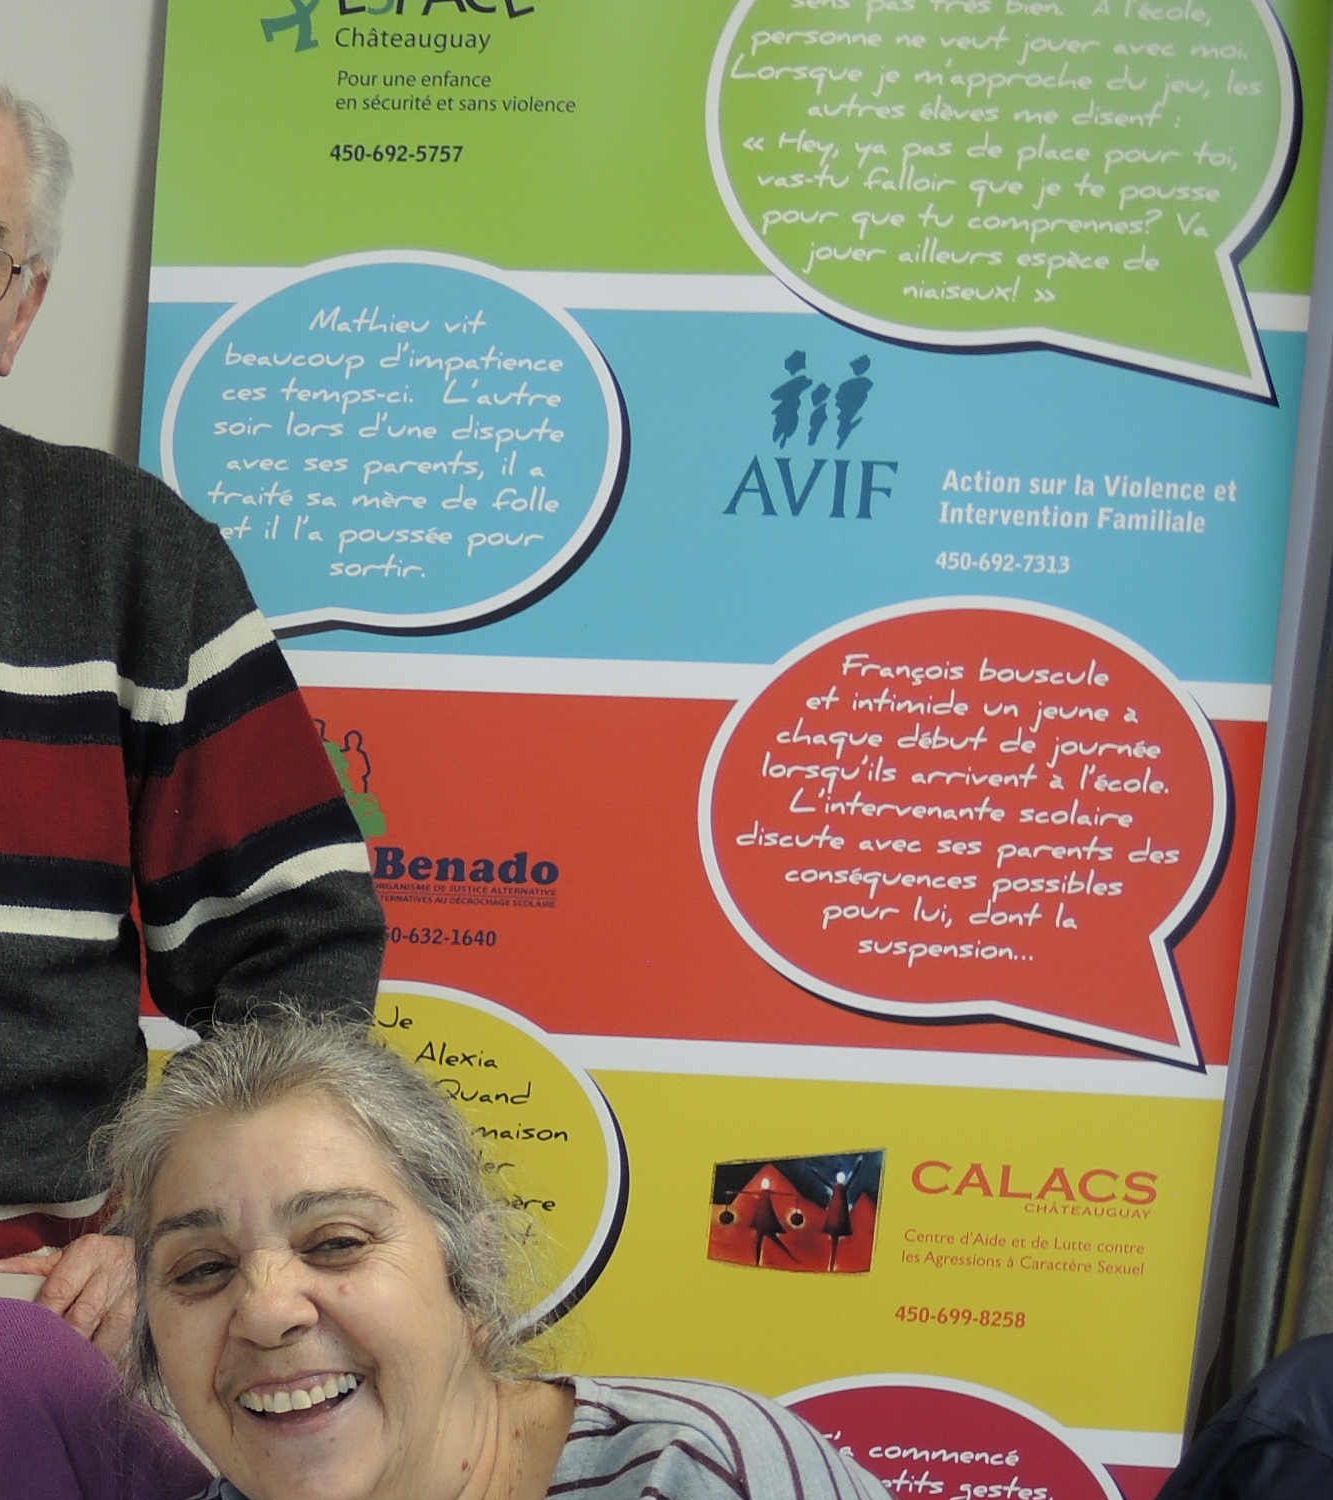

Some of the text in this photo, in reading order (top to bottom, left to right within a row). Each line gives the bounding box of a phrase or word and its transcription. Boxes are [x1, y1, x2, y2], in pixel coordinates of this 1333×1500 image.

[866, 0, 915, 23] pas
[336, 27, 490, 53] Châteauguay
[752, 26, 1247, 66] personne ne veut jouer avec moi.
[338, 70, 491, 87] Pour une enfance
[731, 53, 1261, 103] Lorsque je m'approche du jeu, les
[336, 95, 575, 112] en sécurité et sans violence
[808, 94, 1162, 129] autres élèves me disent
[330, 145, 463, 162] 450-692-5757
[779, 129, 839, 165] Hey,
[902, 141, 952, 161] pas
[966, 131, 1003, 158] de
[1017, 133, 1091, 171] place
[1104, 148, 1181, 174] pour
[1193, 140, 1237, 171] toi,
[864, 168, 956, 193] falloir
[969, 178, 1023, 207] que
[1032, 178, 1061, 210] je
[1074, 172, 1105, 197] te
[1119, 185, 1221, 211] pousse
[763, 202, 1208, 243] pour que tu comprennes? Va
[802, 237, 1161, 279] jouer ailleurs espèce de
[903, 275, 1021, 302] niaiseux!
[309, 306, 486, 334] Mathieu vit
[225, 342, 563, 381] beaucoup d'impatience
[222, 377, 561, 414] ces temps-ci. L'autre
[214, 411, 564, 453] soir lors d'une dispute
[227, 450, 544, 484] avec ses parents, il a
[208, 480, 559, 512] traité sa mère de folle
[723, 455, 898, 519] AVIF
[942, 470, 1237, 502] Action sur la Violence et
[939, 502, 1205, 533] Intervention Familiale
[219, 515, 544, 557] et il l'a poussée pour
[329, 553, 425, 577] sortir.
[936, 552, 1069, 573] 450-692-7313
[842, 654, 1109, 686] François bouscule
[806, 686, 1138, 733] et intimide un jeune à
[777, 717, 1161, 768] chaque début de journée
[762, 752, 1168, 794] lorsqu'ils arrivent à l'école.
[790, 787, 1133, 827] L'intervenante scolaire
[736, 820, 1179, 868] discute avec ses parents des
[373, 847, 559, 885] Benado
[785, 868, 1122, 903] conséquences possibles
[823, 896, 1077, 929] pour lui, dont la
[378, 1006, 412, 1029] Je
[415, 1041, 497, 1068] Alexia
[912, 1161, 1158, 1205] CALACS
[1025, 1204, 1150, 1219] CHÂTEAUGUAY
[905, 1229, 1144, 1254] Centre d'Aide et de Lutte contre
[902, 1249, 1144, 1275] les Agressions à Caractère Sexuel
[895, 1306, 1025, 1328] 450-699-8258
[869, 1446, 1019, 1466] commencé
